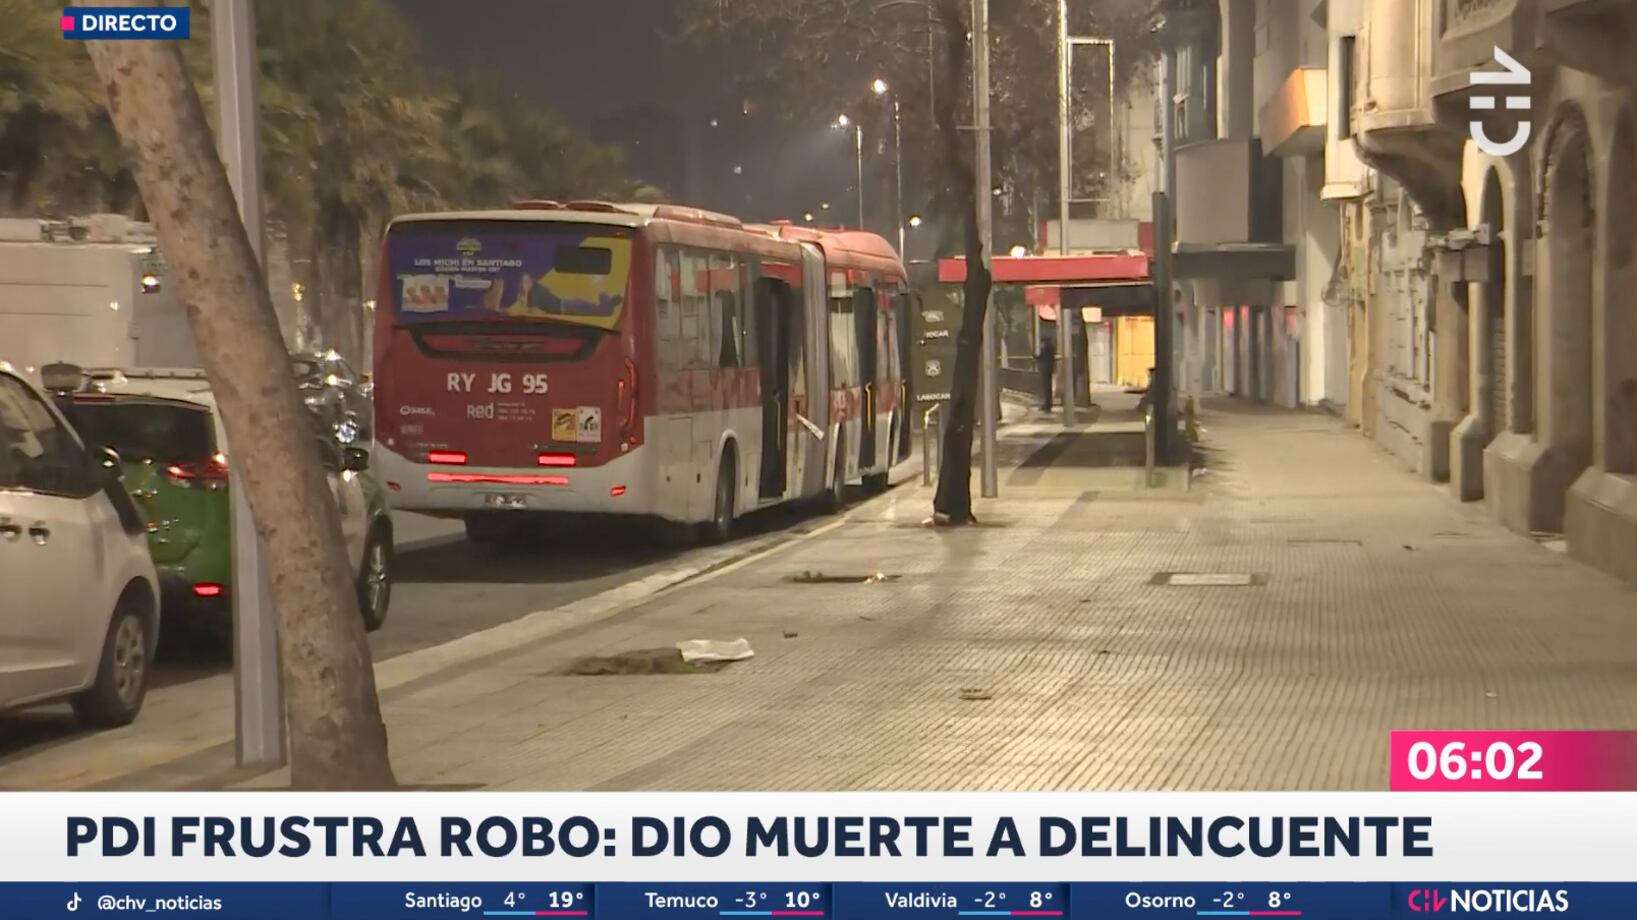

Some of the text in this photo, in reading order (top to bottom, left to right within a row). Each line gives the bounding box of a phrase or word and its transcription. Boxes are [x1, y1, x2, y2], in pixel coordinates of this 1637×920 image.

[476, 258, 523, 268] SANTIAGO
[446, 372, 548, 394] RY JG 95
[466, 402, 494, 419] Red
